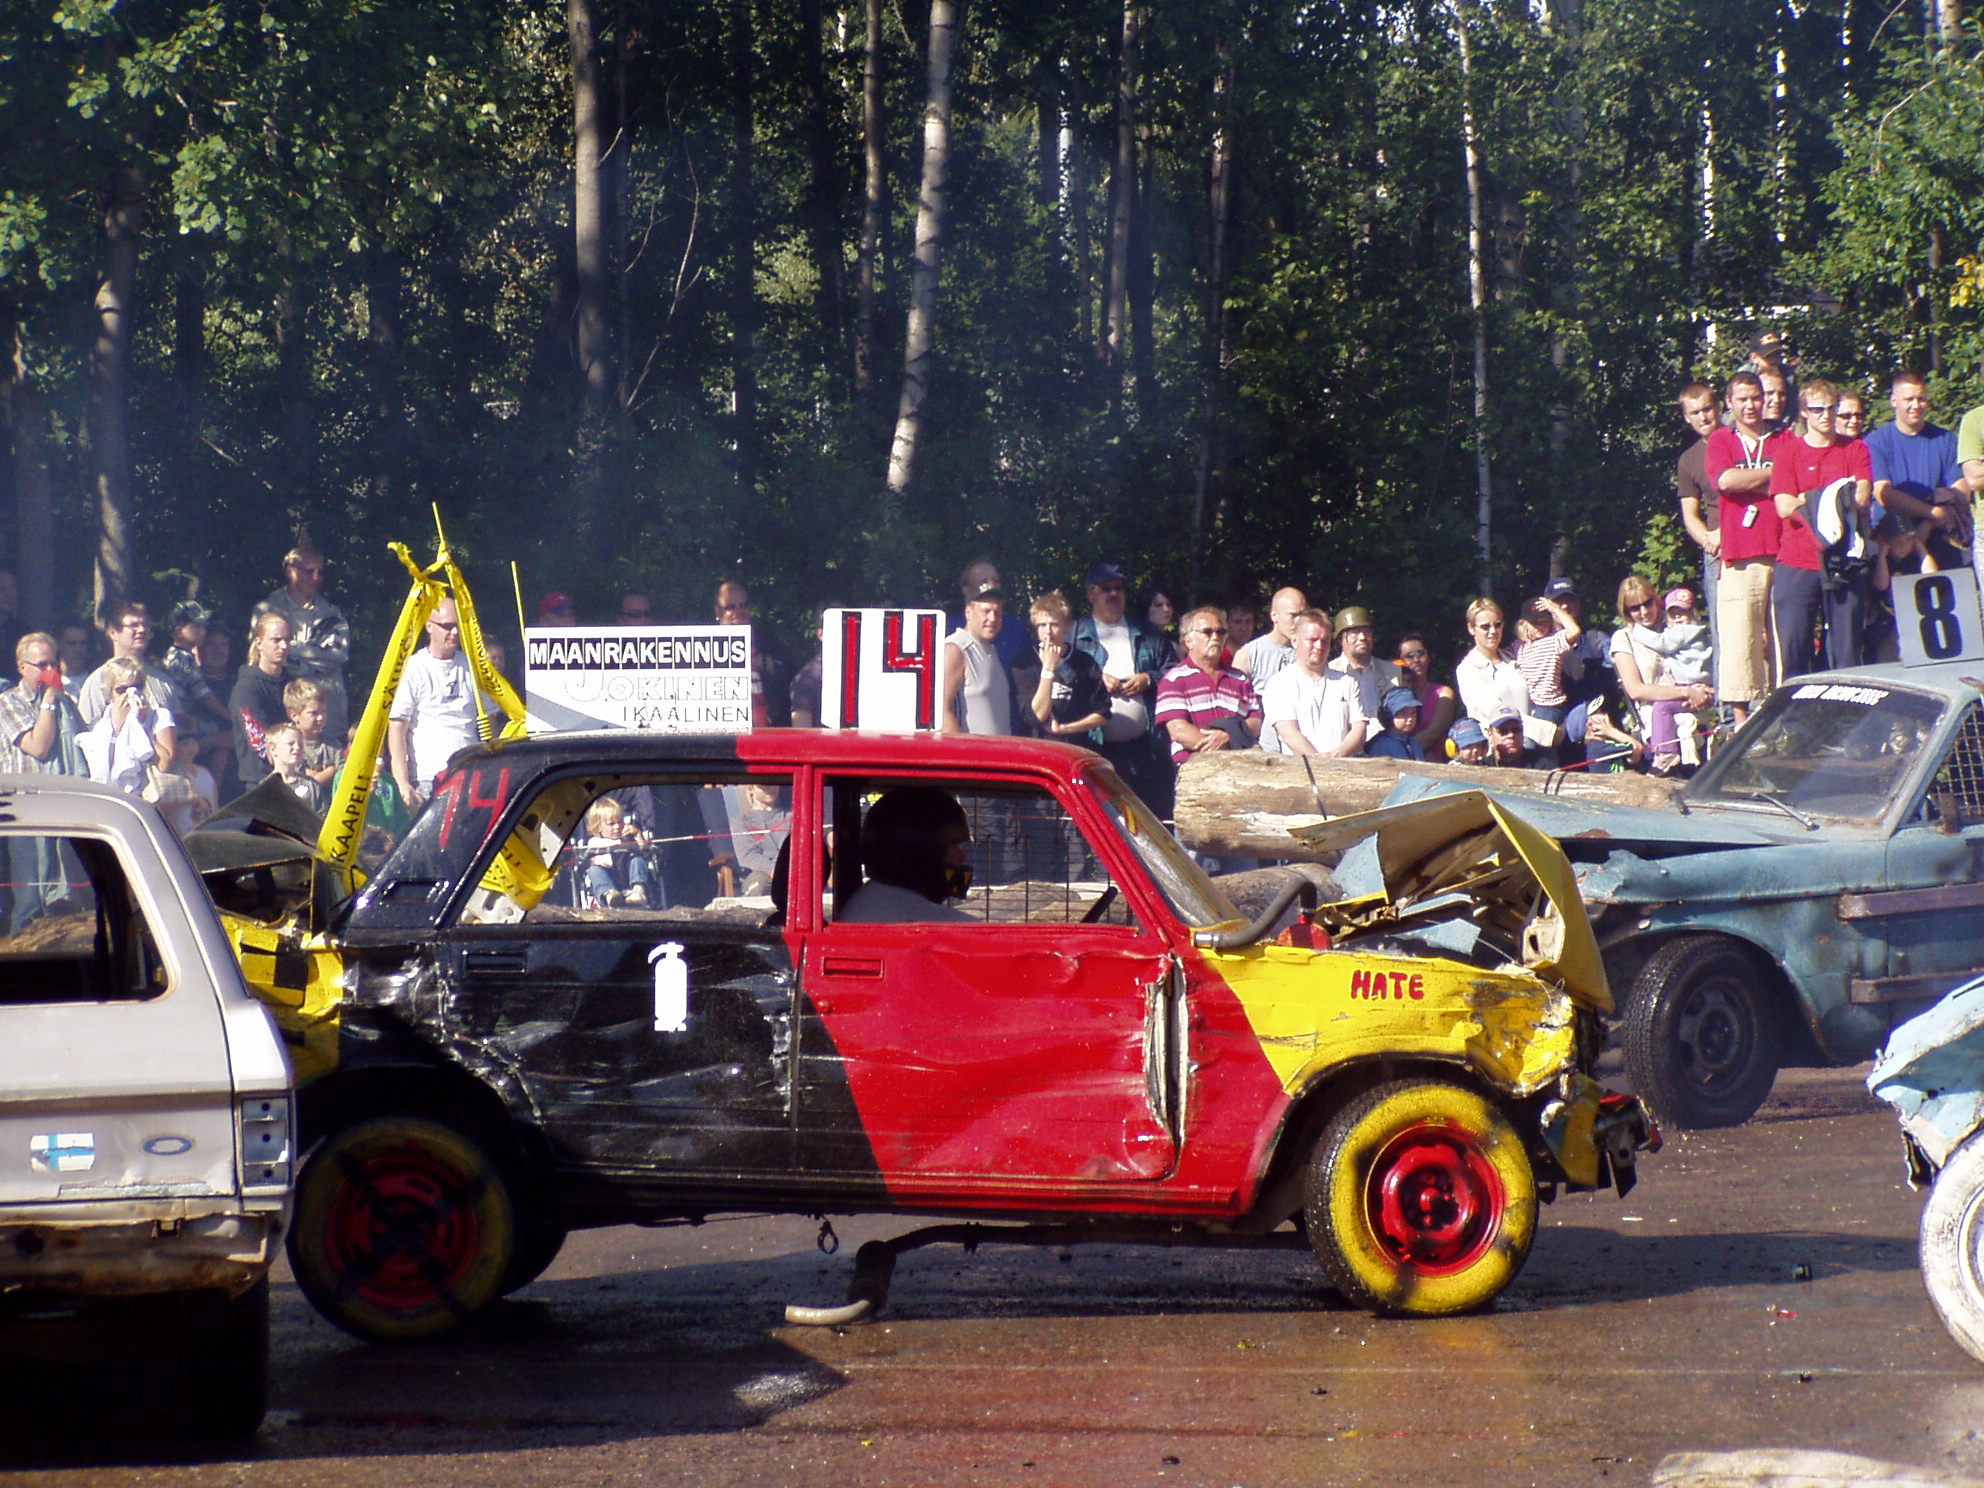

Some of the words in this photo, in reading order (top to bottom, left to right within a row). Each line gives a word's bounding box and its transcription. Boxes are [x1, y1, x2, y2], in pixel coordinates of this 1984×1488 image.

[1915, 575, 1962, 660] 8
[530, 638, 746, 666] MAANRAKENNUS
[840, 611, 936, 729] 14
[564, 668, 749, 703] JOKINEN
[623, 706, 749, 724] IKAALINEN
[331, 775, 370, 862] KAAPELI
[434, 767, 510, 853] 14
[1351, 969, 1424, 1000] HATE
